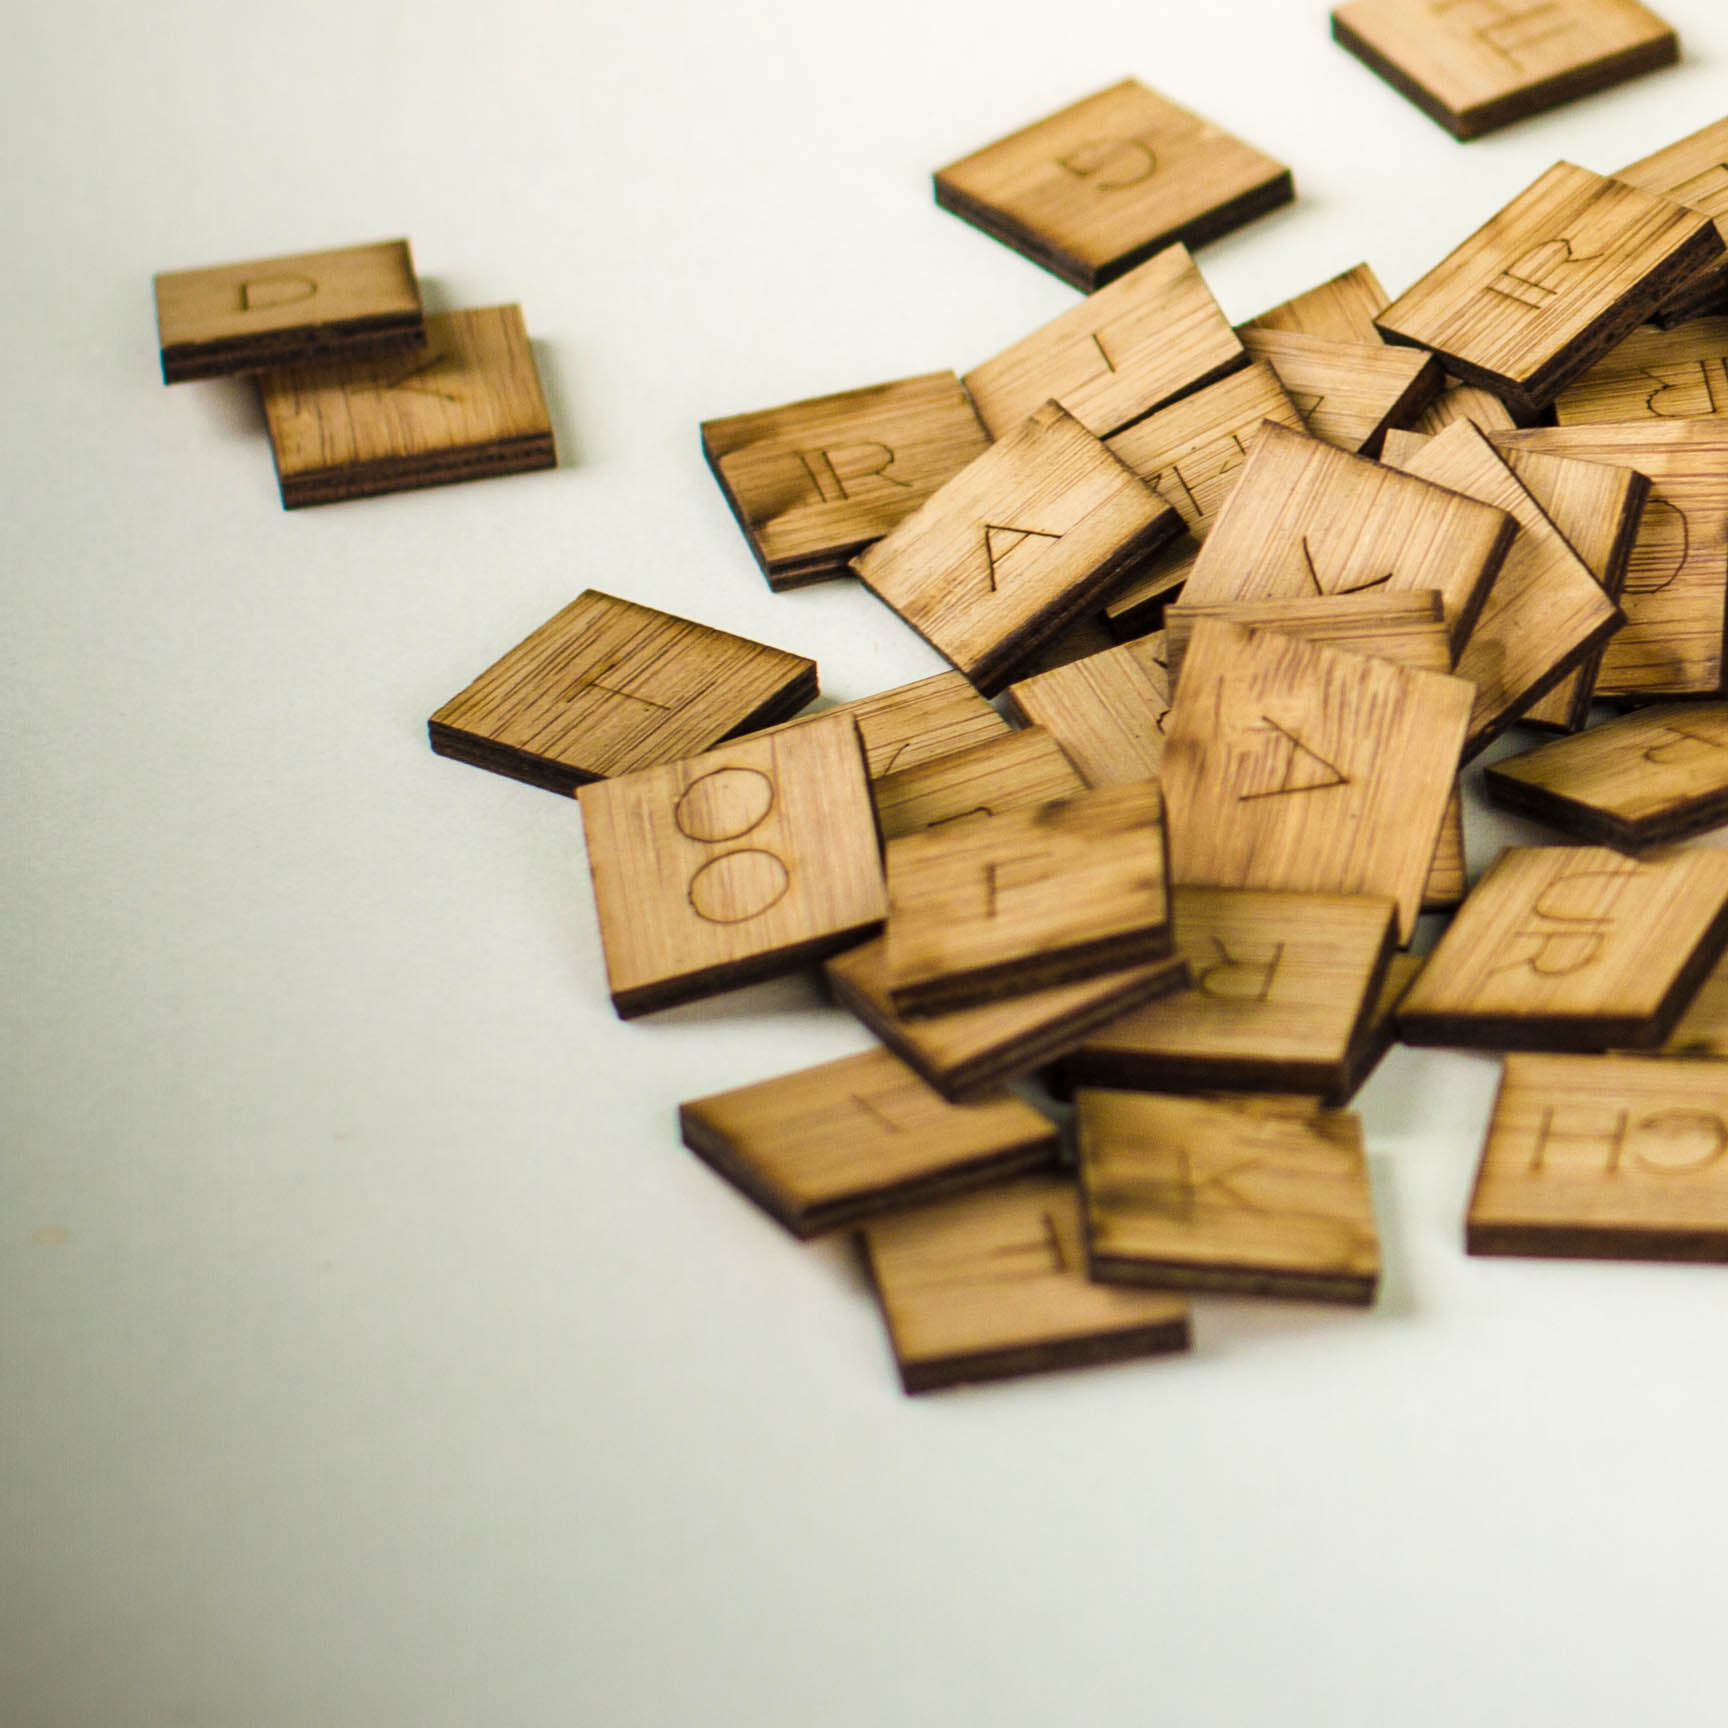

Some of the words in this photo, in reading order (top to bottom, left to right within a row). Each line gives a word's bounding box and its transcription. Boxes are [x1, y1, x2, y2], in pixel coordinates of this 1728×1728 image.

[1486, 238, 1604, 310] IR
[799, 441, 913, 503] IR
[984, 524, 1064, 593] A
[1238, 715, 1351, 802] A
[1200, 935, 1286, 1002] R
